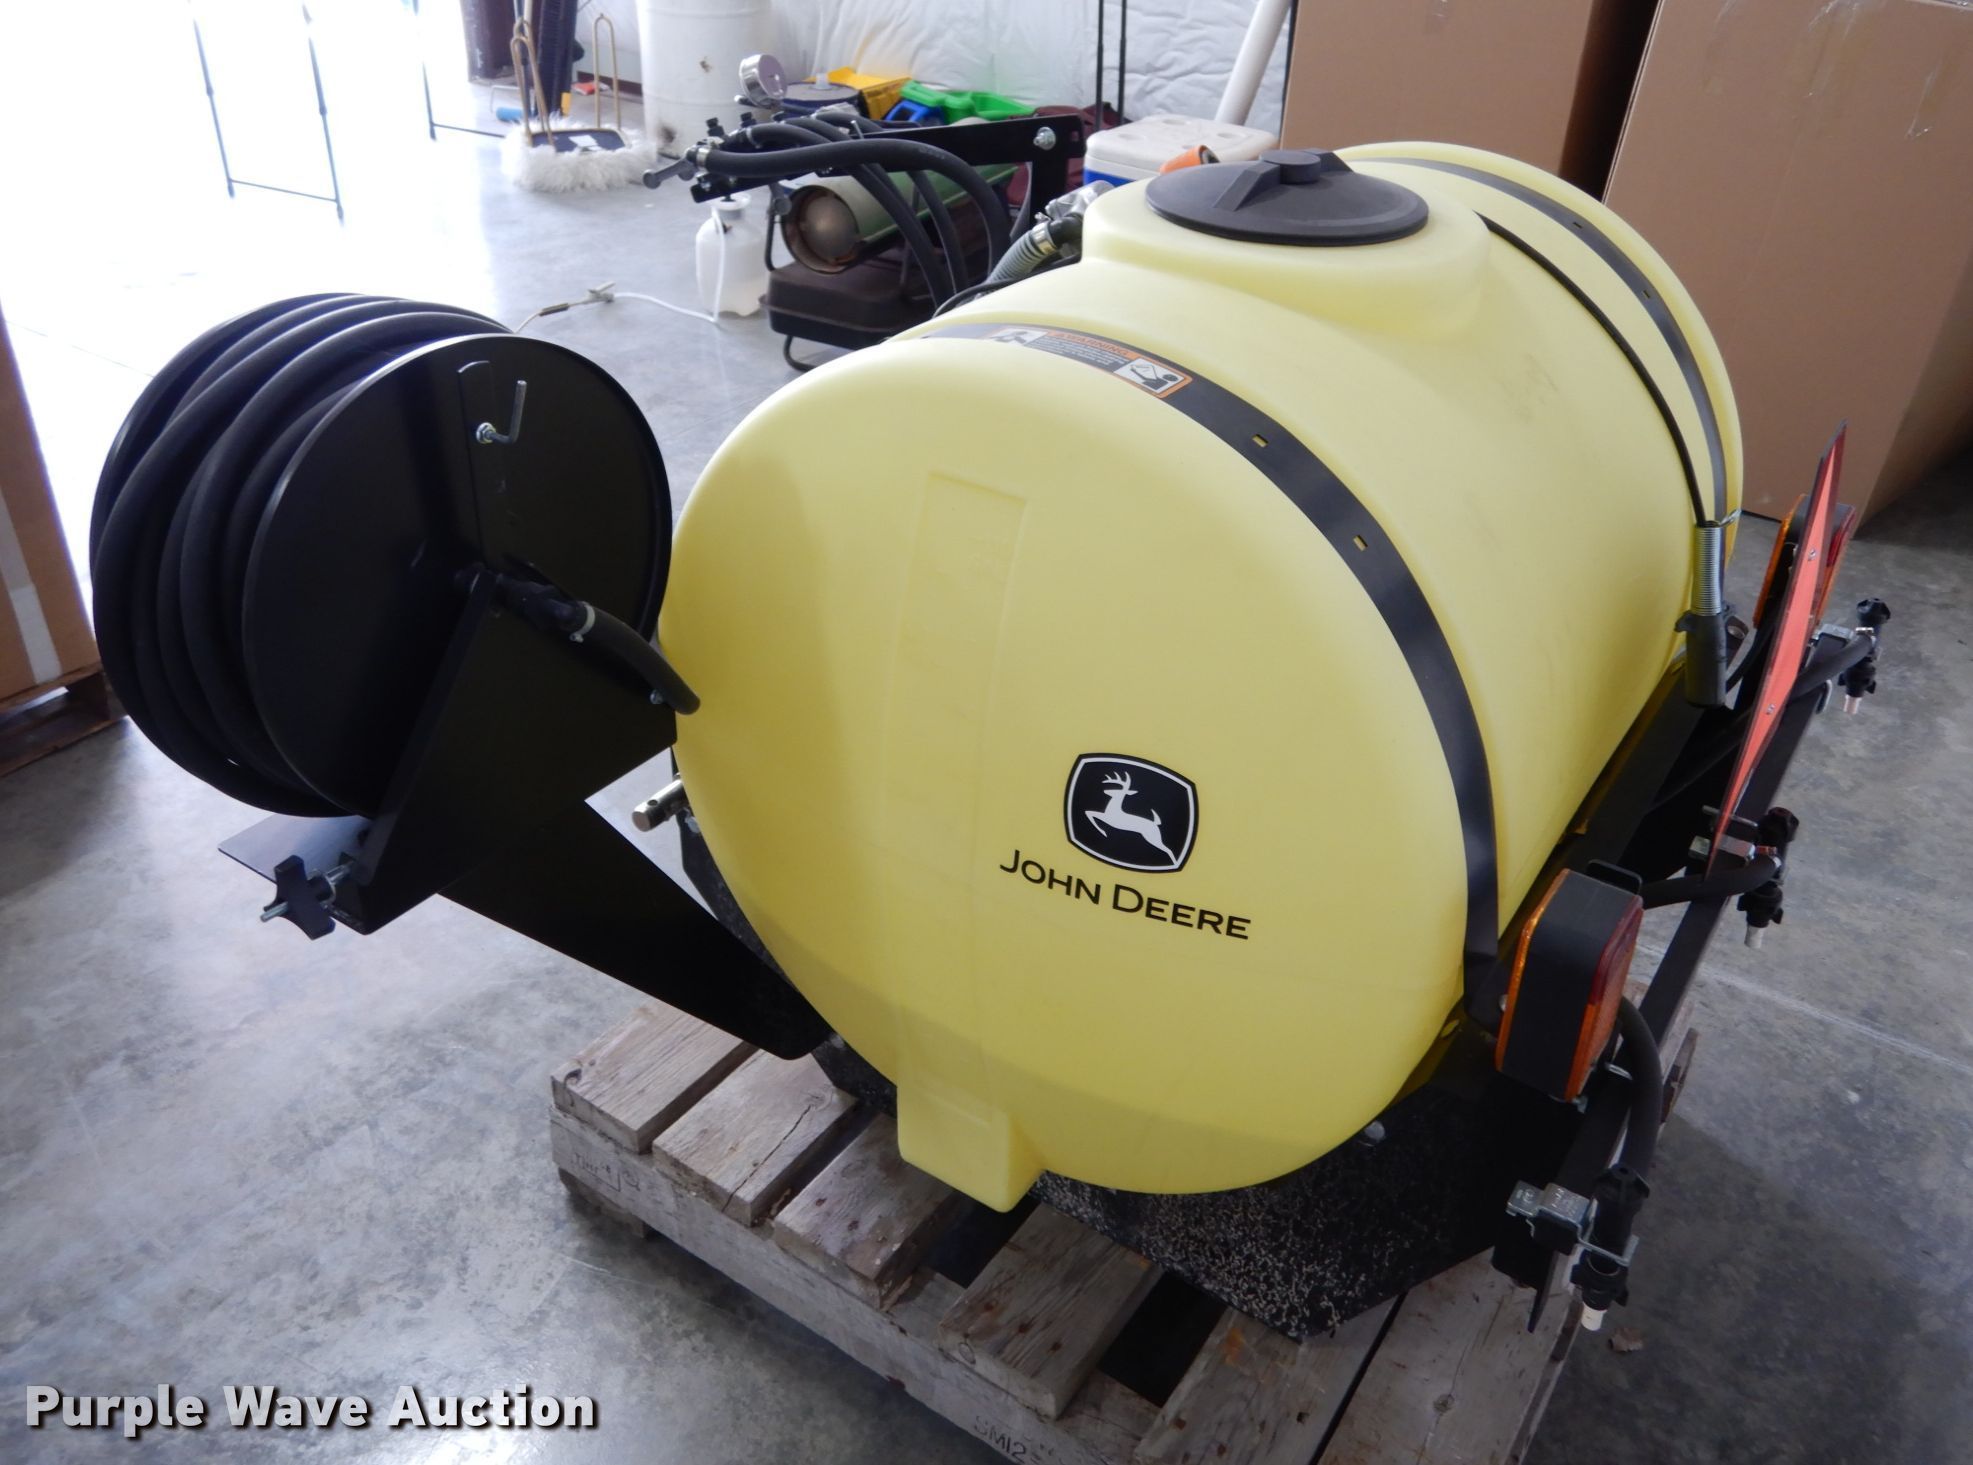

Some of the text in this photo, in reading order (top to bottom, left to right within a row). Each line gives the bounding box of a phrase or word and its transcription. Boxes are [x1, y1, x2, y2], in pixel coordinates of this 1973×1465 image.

[1067, 334, 1128, 357] WARNING
[999, 849, 1252, 940] JOHN DEERE
